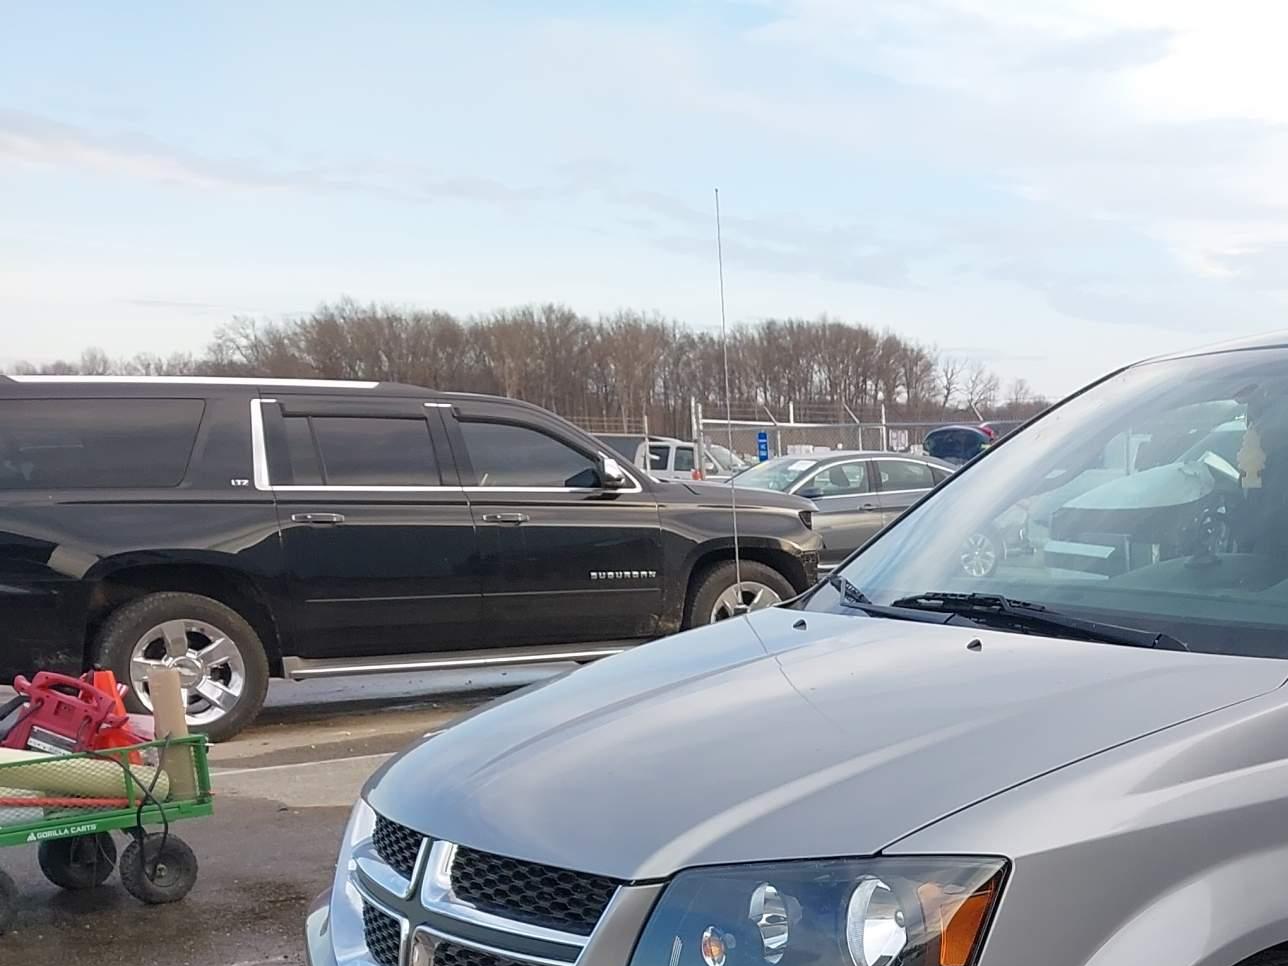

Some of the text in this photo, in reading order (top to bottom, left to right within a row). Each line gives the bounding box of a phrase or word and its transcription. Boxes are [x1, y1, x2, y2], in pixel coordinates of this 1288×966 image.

[590, 571, 657, 580] SUBURBAN
[36, 824, 96, 839] GORILLA CARTS
